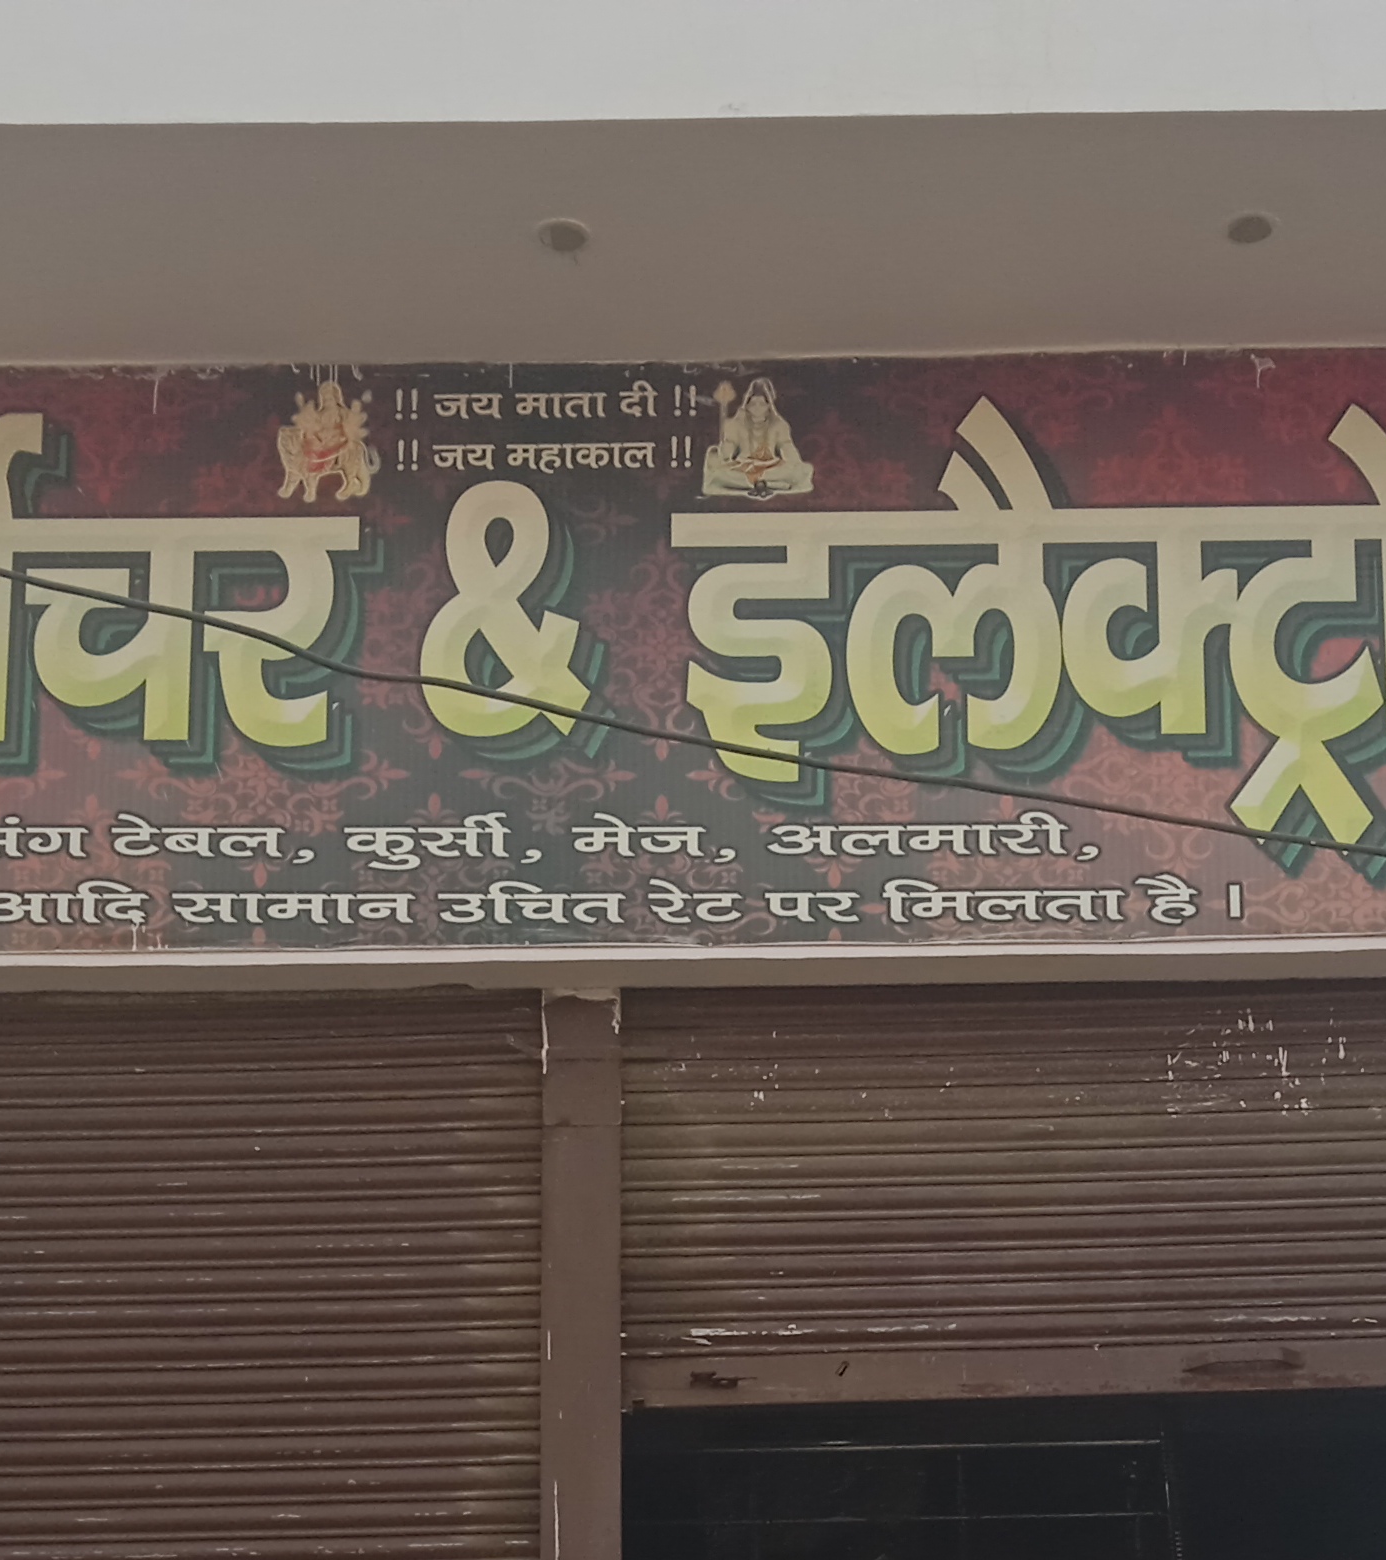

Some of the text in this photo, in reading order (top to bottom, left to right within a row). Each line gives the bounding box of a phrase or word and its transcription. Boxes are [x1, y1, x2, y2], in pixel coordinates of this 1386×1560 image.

[433, 393, 503, 420] जय
[515, 391, 607, 419] माता
[619, 380, 659, 418] दी
[432, 444, 495, 471] जय
[506, 441, 656, 474] महाकाल
[419, 478, 592, 738] &
[112, 813, 315, 864] टेबल,
[344, 812, 543, 871] कुर्सी,
[571, 812, 736, 863] मेज,
[766, 811, 1099, 861] अलमारी,
[172, 892, 417, 925] सामान
[437, 880, 627, 924] उचित
[647, 878, 742, 924] रेट
[764, 890, 861, 923] पर
[882, 877, 1124, 923] मिलता
[1134, 874, 1199, 925] है
